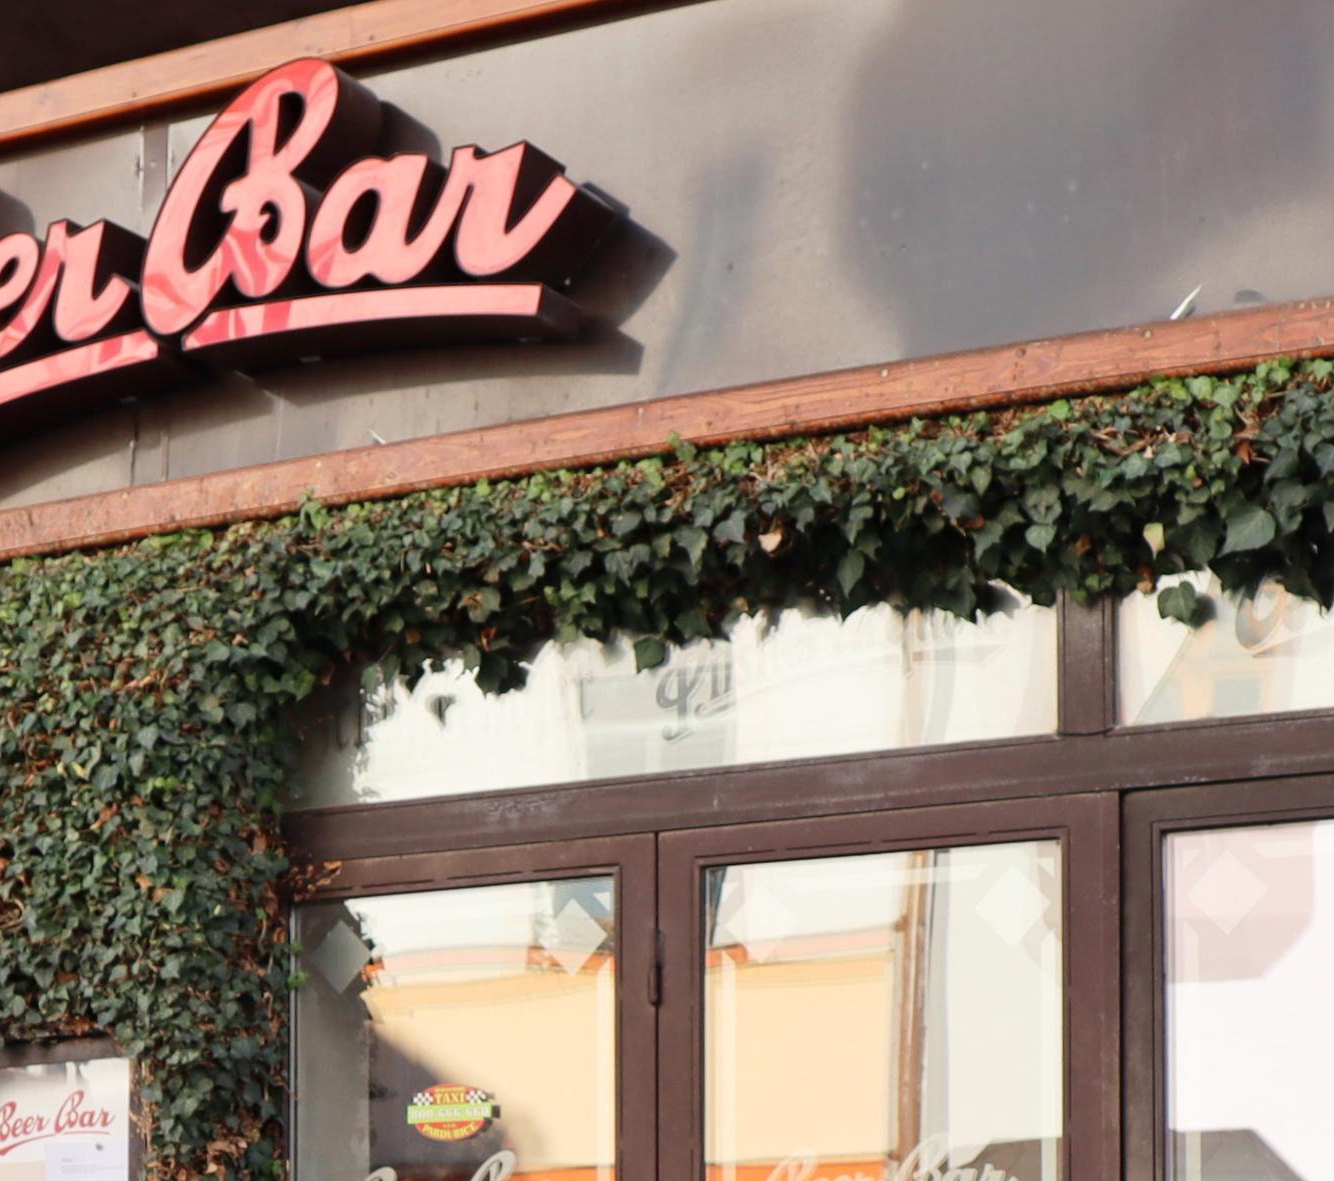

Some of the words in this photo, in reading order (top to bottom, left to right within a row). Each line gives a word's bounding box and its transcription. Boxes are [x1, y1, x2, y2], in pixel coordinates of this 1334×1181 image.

[141, 57, 576, 337] Bar
[54, 1090, 115, 1133] Bar
[433, 1092, 464, 1104] TAXI
